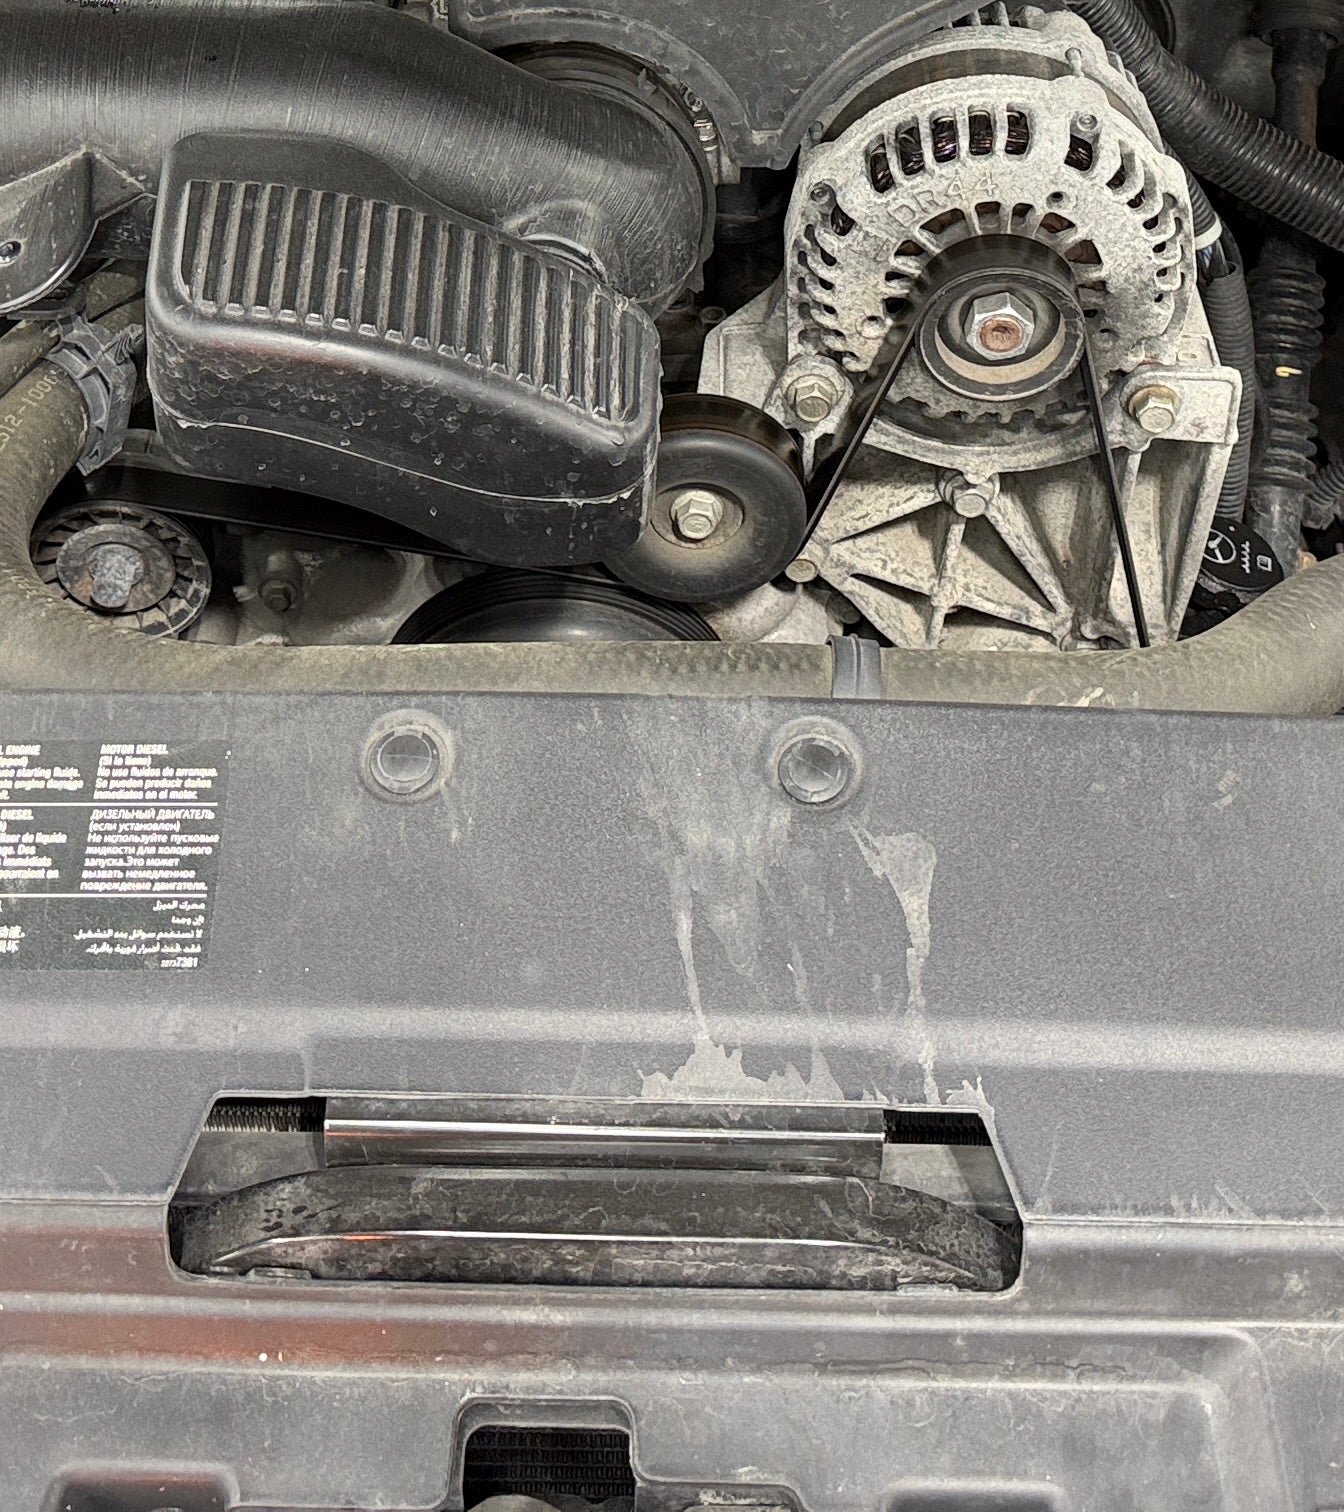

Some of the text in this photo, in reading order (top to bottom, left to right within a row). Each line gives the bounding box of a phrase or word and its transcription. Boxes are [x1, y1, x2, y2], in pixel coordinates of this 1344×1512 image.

[5, 745, 41, 757] ENGINE
[100, 744, 135, 756] MOTOR
[90, 808, 215, 821] ДИЗЕЛЬНЫЙ ДВИГАТЕЛЬ
